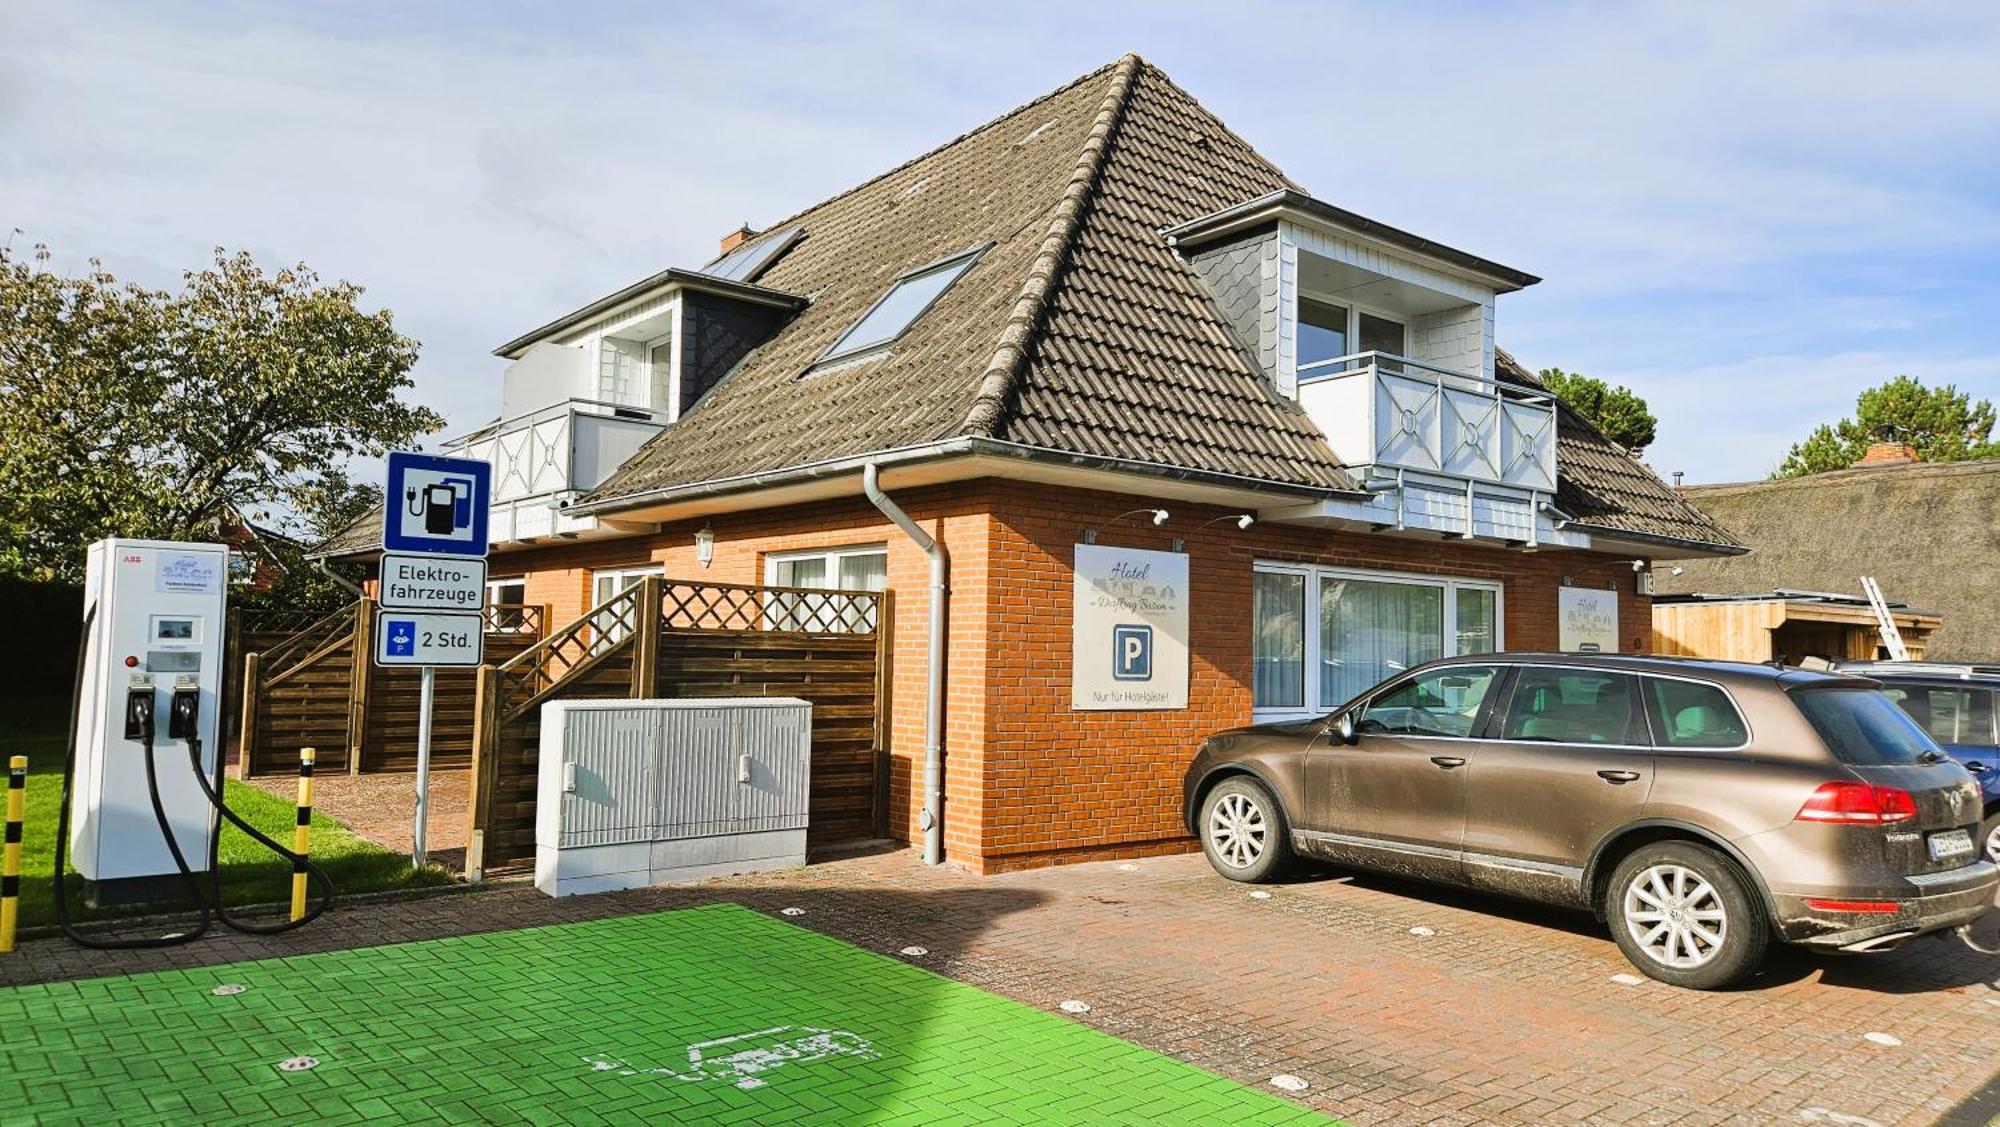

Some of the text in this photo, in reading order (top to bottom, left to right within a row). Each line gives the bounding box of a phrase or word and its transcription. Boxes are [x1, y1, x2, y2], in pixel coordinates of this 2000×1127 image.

[399, 565, 470, 582] Elektro-
[390, 583, 476, 604] fahrzeuge
[422, 631, 472, 648] 2 Std.
[1124, 637, 1143, 671] P
[1093, 691, 1108, 702] Nur
[1111, 691, 1123, 702] für
